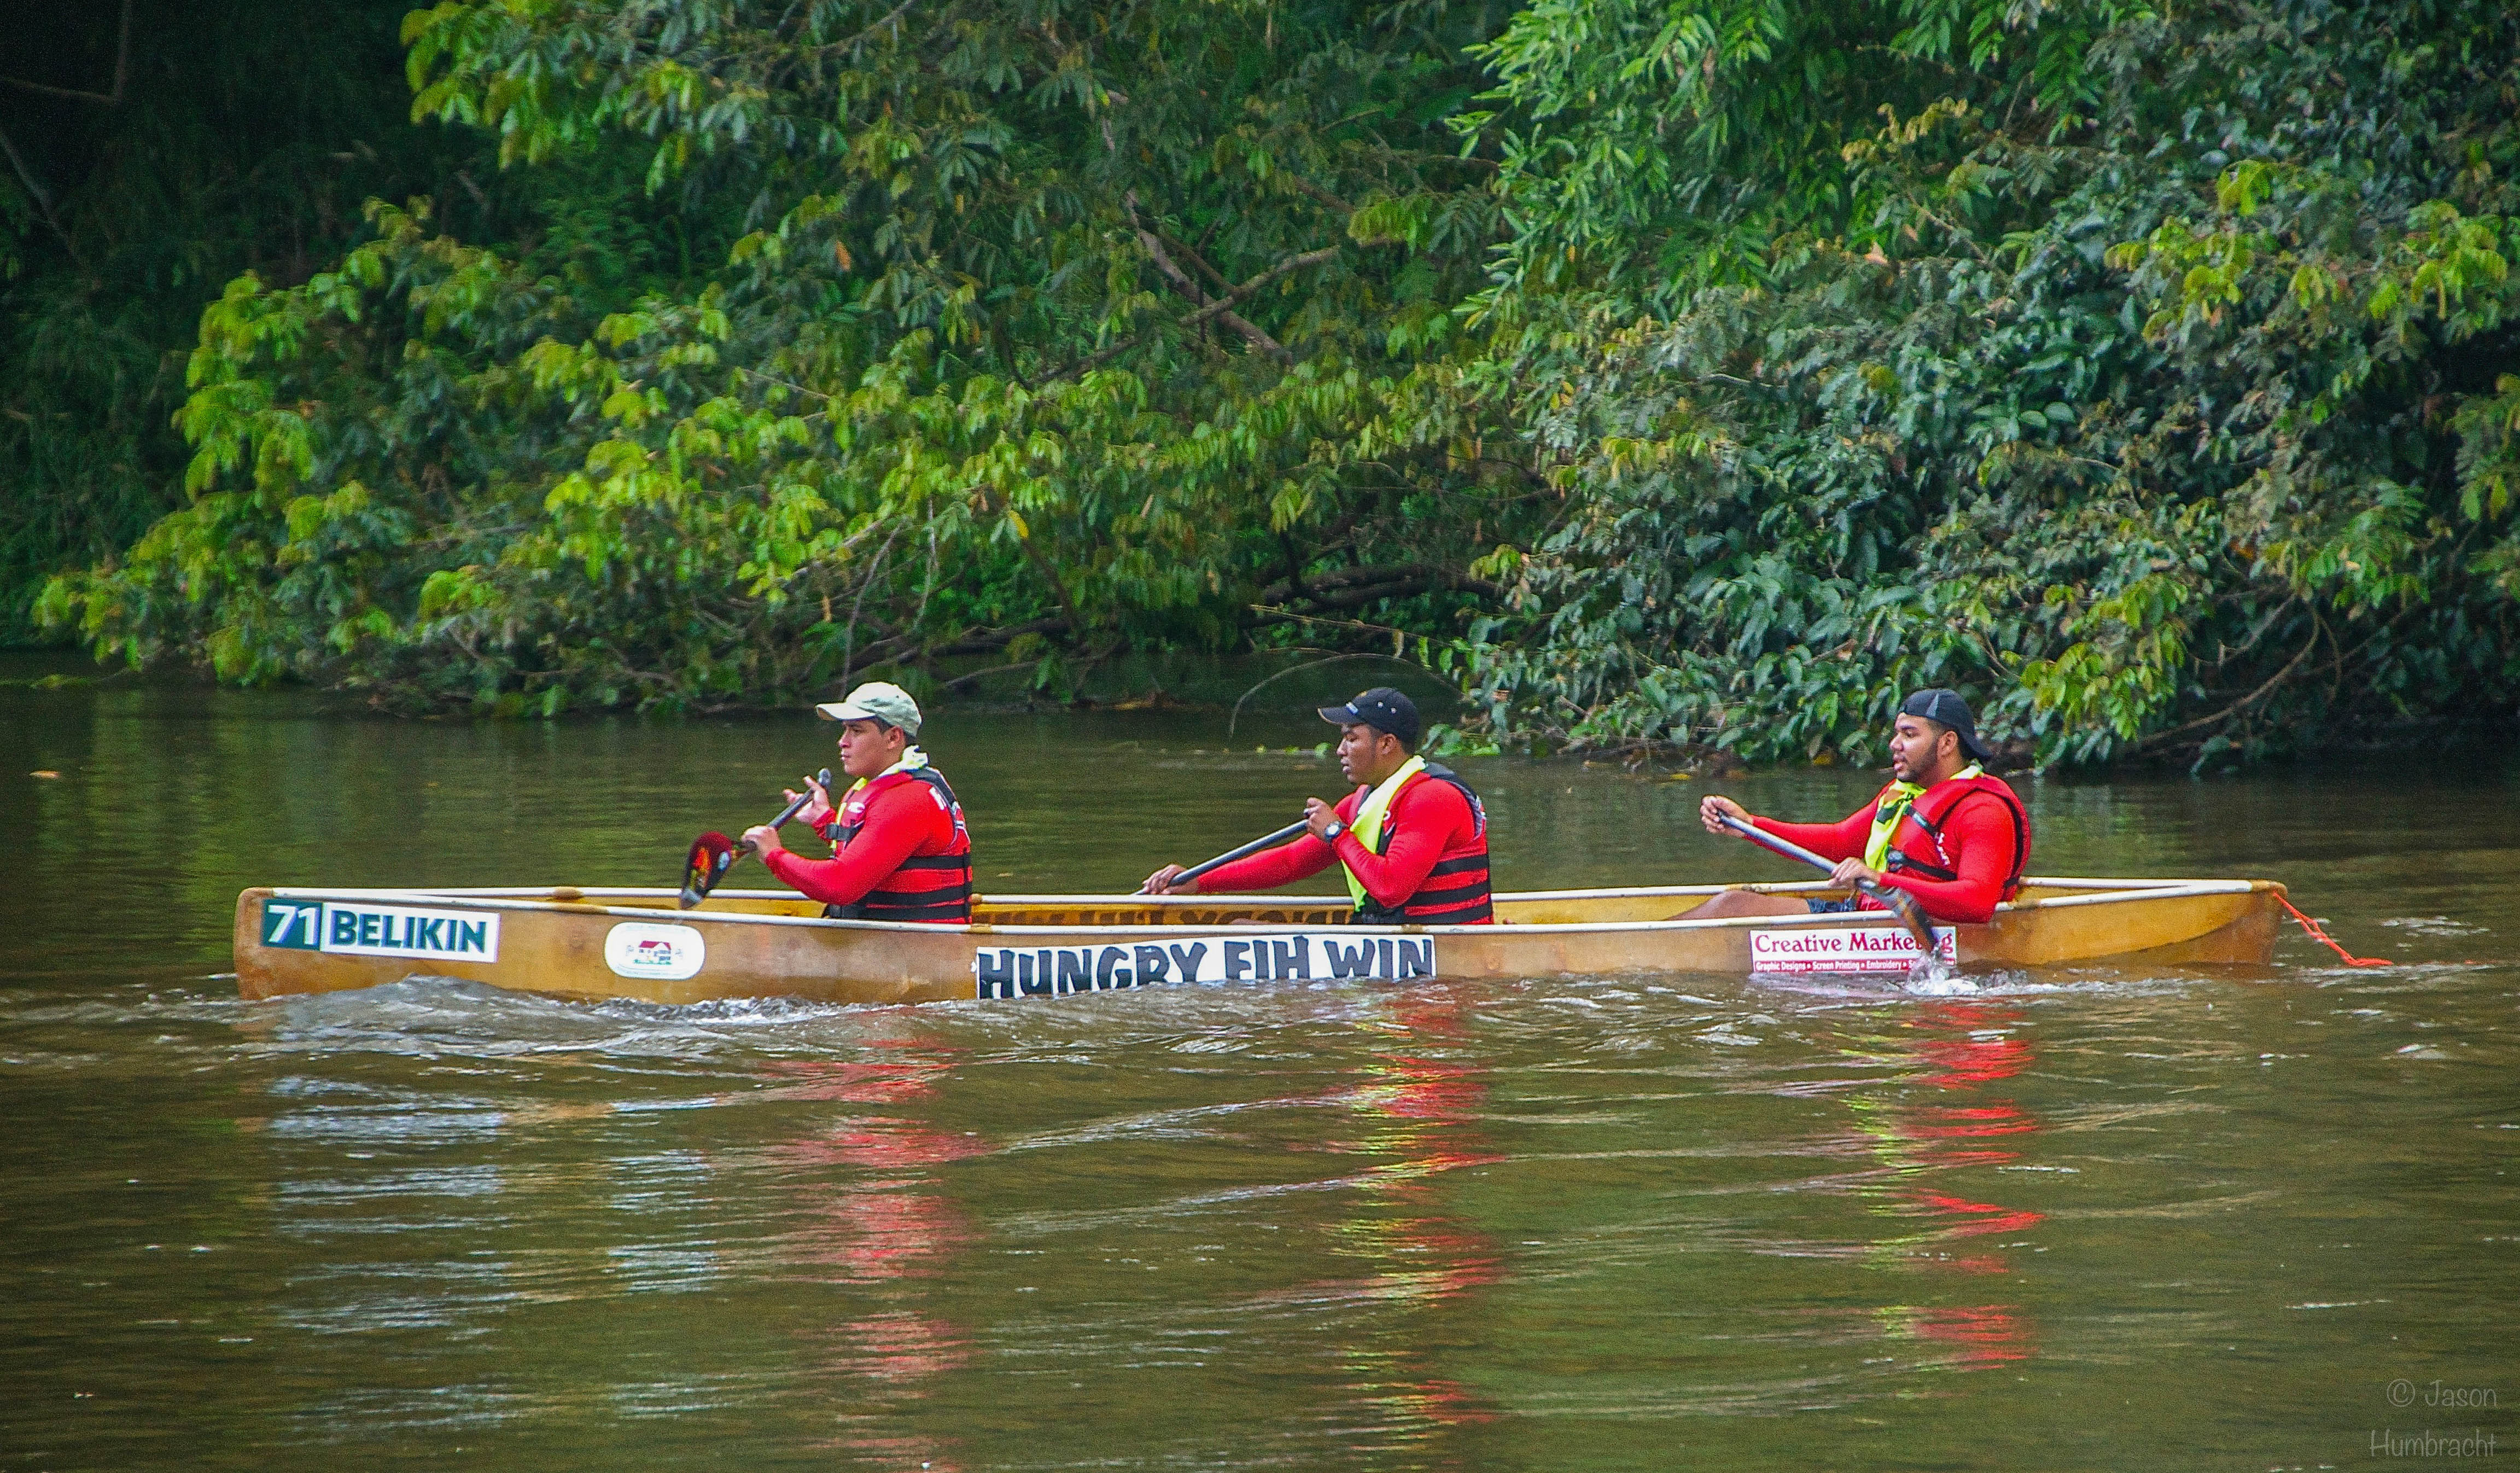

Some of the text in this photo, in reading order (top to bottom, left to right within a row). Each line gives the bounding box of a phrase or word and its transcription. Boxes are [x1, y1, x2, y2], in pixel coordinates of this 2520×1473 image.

[267, 905, 320, 945] 71
[329, 910, 487, 953] BELIKIN
[1755, 931, 1953, 954] Creative Markeg
[978, 942, 1208, 999] HUNGRY
[1324, 939, 1432, 979] WIN
[1755, 962, 1781, 972] Graphic
[1781, 961, 1805, 972] Designs
[1812, 960, 1834, 970] Screen
[1835, 960, 1860, 971] Printing
[1866, 960, 1902, 970] Embroidery
